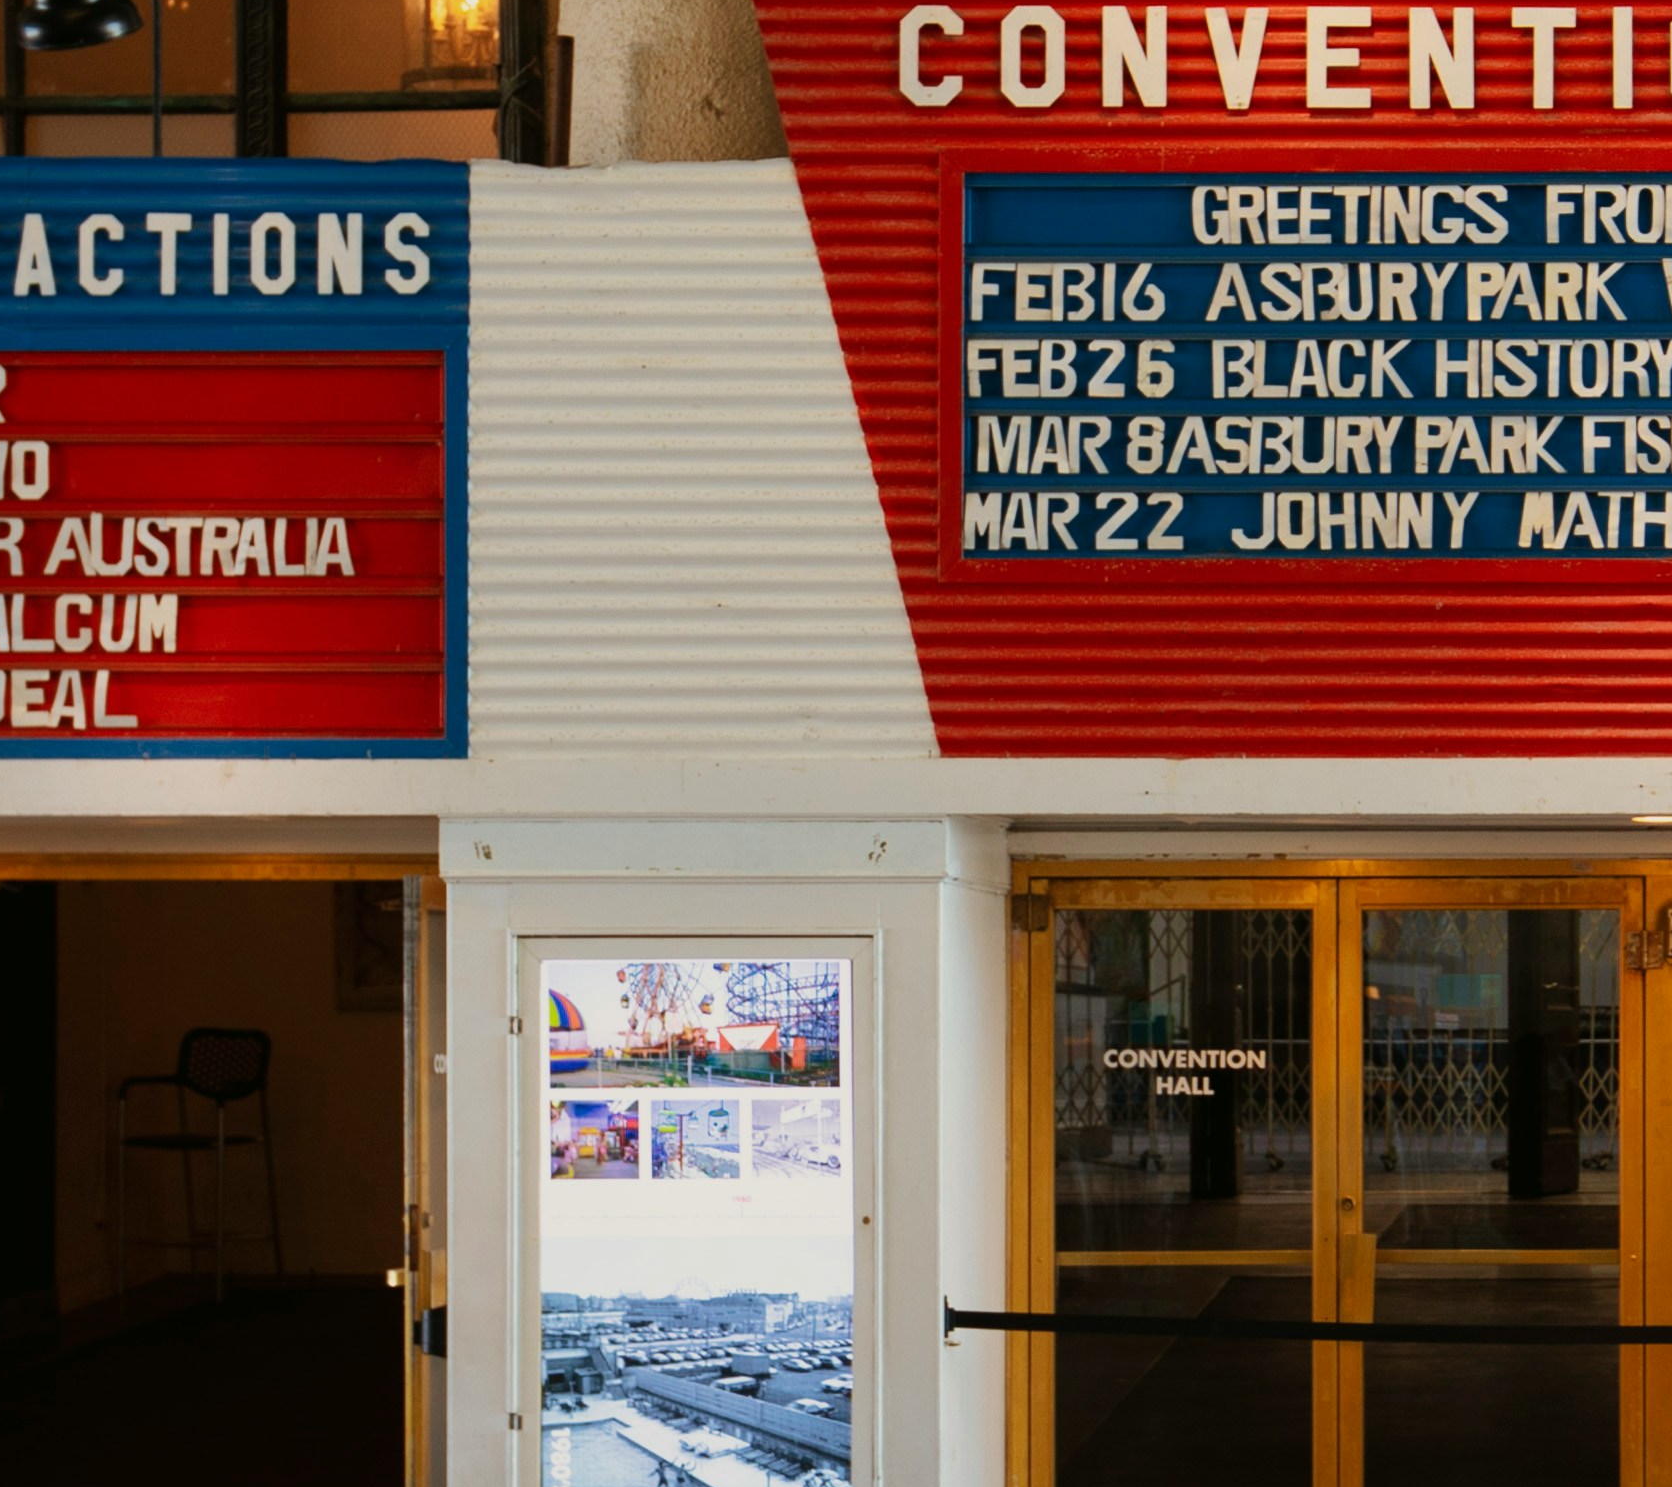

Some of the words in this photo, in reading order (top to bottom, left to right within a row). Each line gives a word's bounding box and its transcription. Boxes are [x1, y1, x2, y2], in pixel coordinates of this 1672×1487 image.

[1192, 185, 1507, 245] GREETINGS
[967, 339, 1076, 398] FEB
[1088, 339, 1175, 398] 26
[1212, 339, 1413, 398] BLACK
[976, 416, 1109, 475] MAR
[43, 511, 356, 577] AUSTRALIA
[962, 492, 1079, 550] MAR
[1094, 492, 1185, 550] 22
[1230, 492, 1479, 550] JOHNNY
[1103, 1049, 1267, 1070] CONVENTION
[1155, 1075, 1215, 1096] HALL
